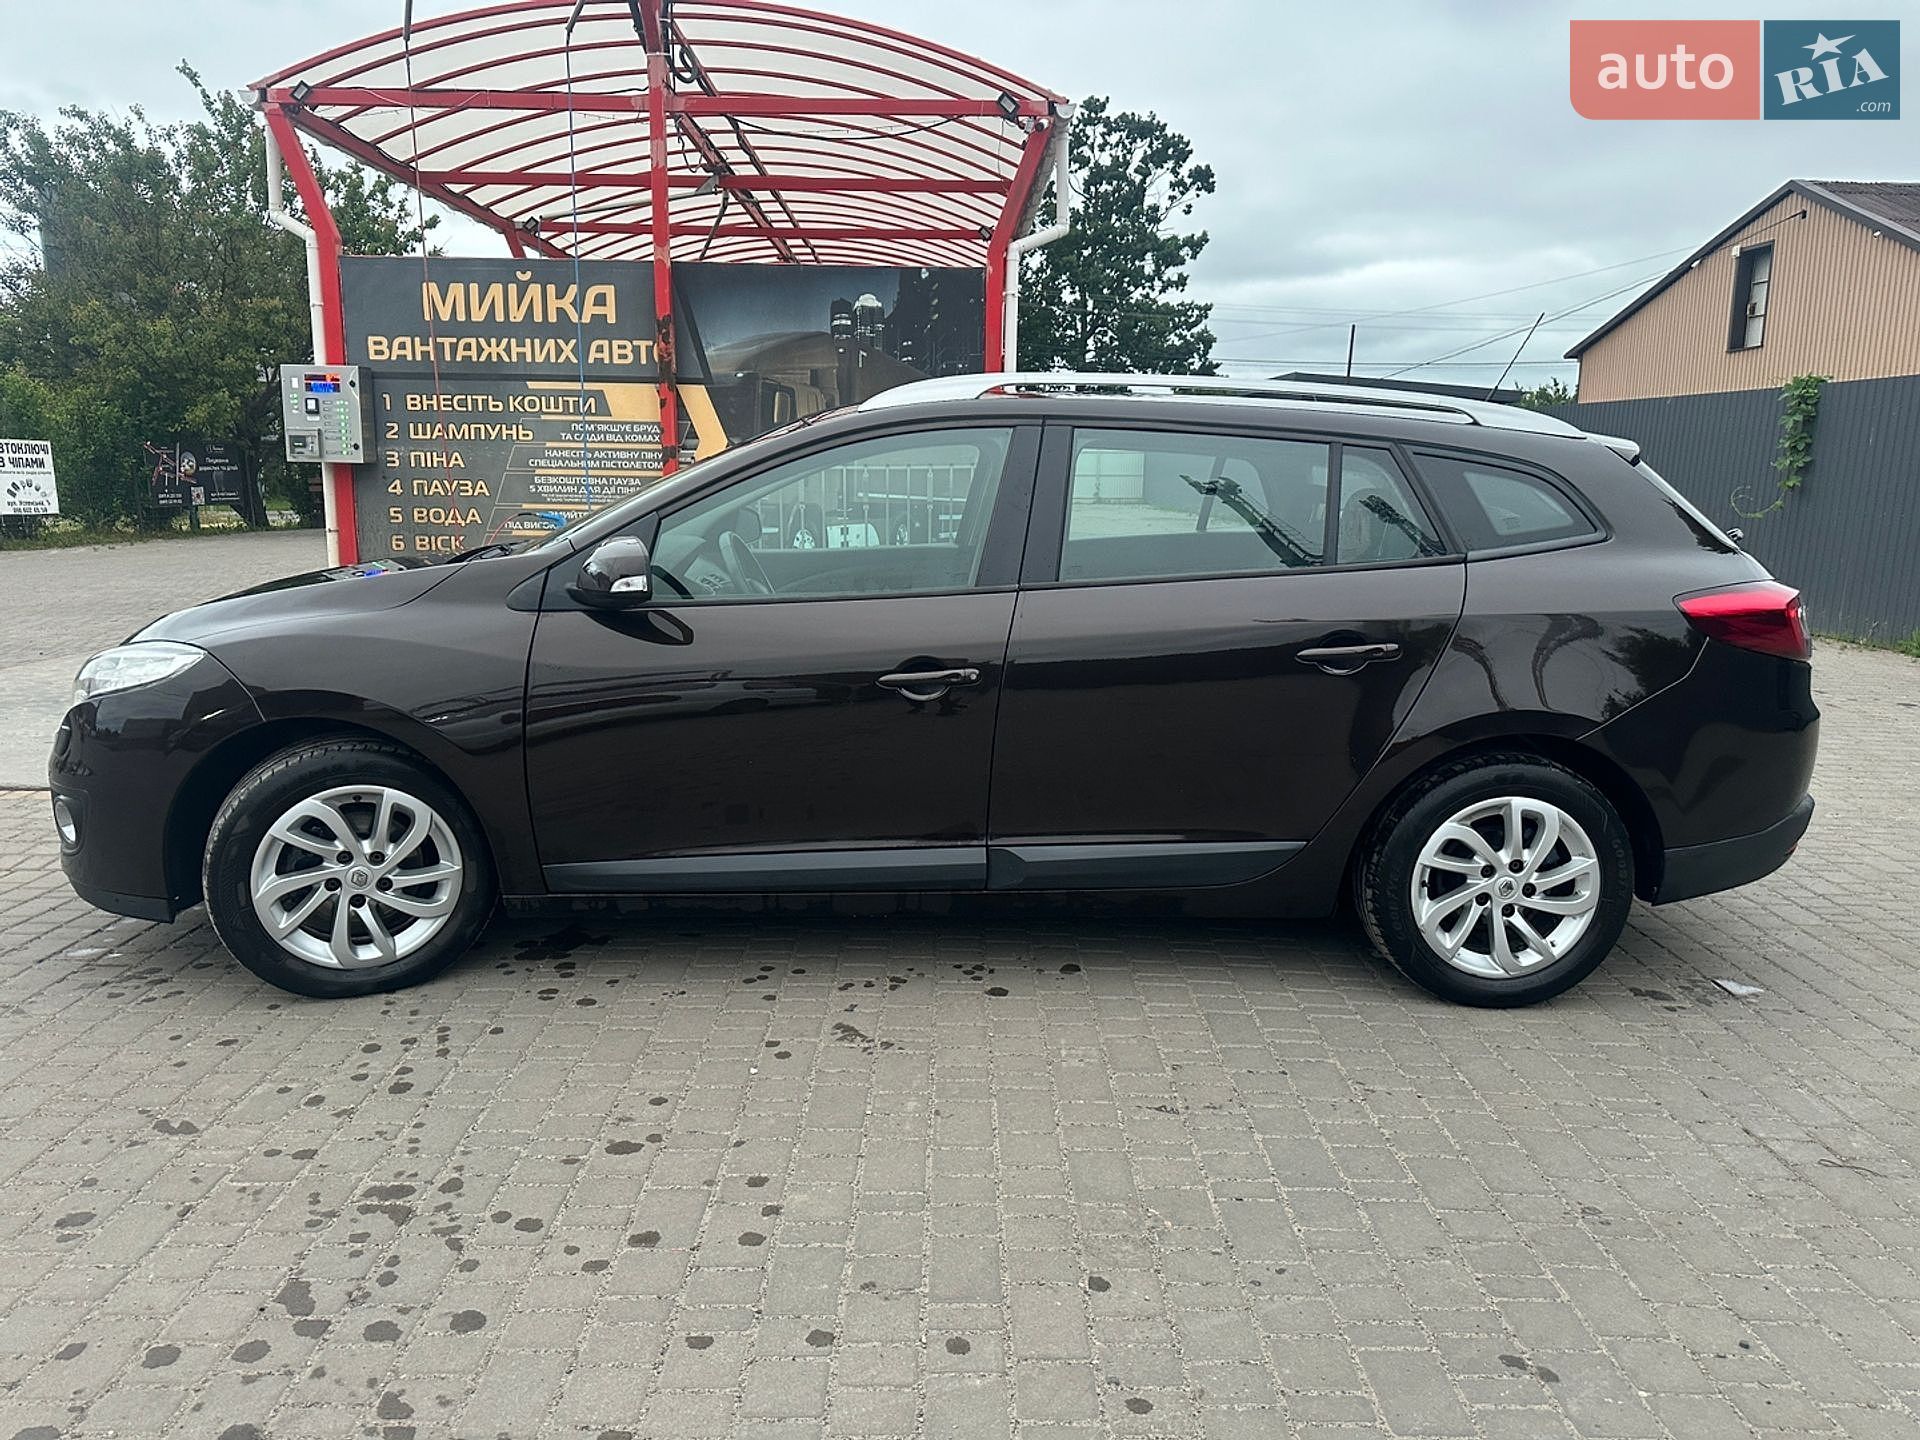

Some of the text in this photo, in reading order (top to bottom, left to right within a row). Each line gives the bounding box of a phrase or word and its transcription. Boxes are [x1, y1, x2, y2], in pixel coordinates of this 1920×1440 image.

[421, 269, 617, 324] МИЙКА
[366, 335, 579, 364] ВАНТАЖНИХ
[382, 393, 597, 414] 1 ВНЕСІТЬ КОШТИ
[385, 422, 534, 441] 2 ШАМПУНЬ
[560, 432, 573, 441] ТА
[605, 433, 624, 442] ВІД
[625, 433, 660, 442] КОМАХ
[633, 424, 660, 433] БРУД
[8, 456, 46, 469] ЧІПАМИ
[386, 451, 466, 468] 3 ПІНА
[593, 450, 640, 459] АКТИВНУ
[641, 451, 663, 460] ПІНУ
[601, 460, 664, 469] ПІСТОЛЕТОМ
[387, 479, 491, 497] 4 ПАУЗА
[609, 477, 642, 486] ПАУЗА
[389, 507, 482, 526] 5 ВОДА
[391, 535, 465, 552] 6 ВІСК
